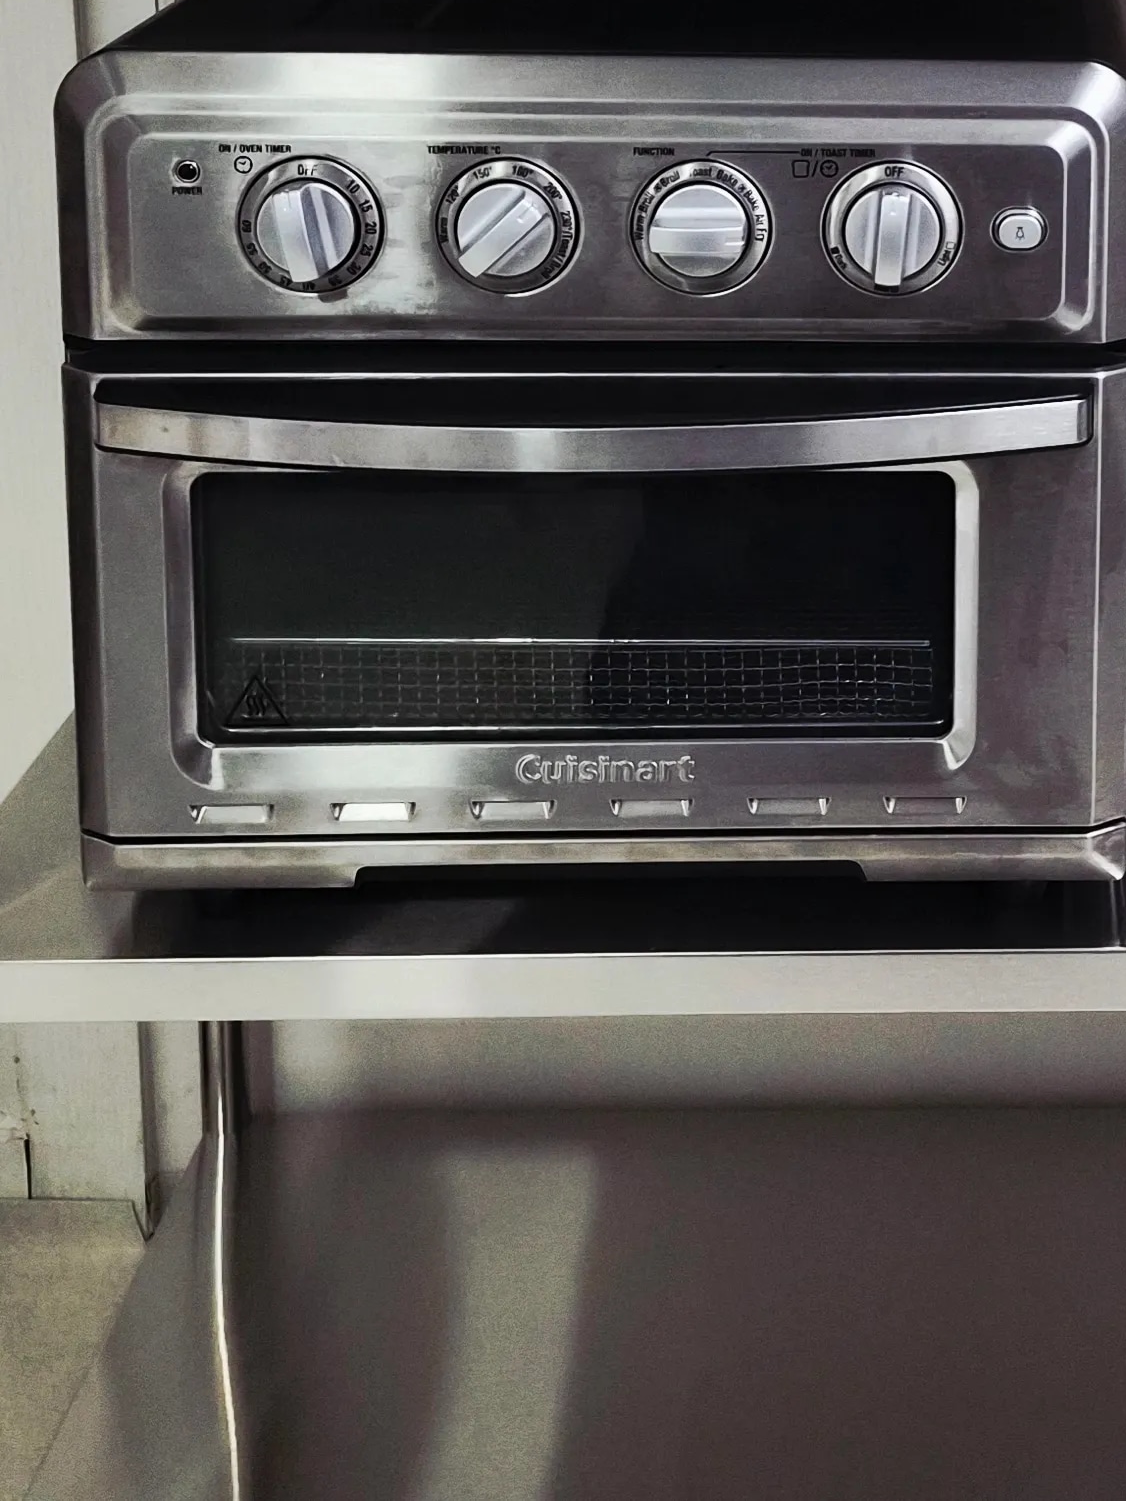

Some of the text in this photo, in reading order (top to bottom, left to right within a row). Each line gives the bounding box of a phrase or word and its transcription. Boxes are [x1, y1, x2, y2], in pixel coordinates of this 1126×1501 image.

[239, 144, 262, 153] OVEN
[427, 145, 489, 154] TEMPERATURE
[633, 146, 675, 156] FUNCTION
[821, 149, 847, 157] TOAST
[884, 166, 905, 177] OFF
[359, 199, 373, 213] 15
[365, 221, 377, 235] 20
[515, 753, 696, 785] Cuisinart
